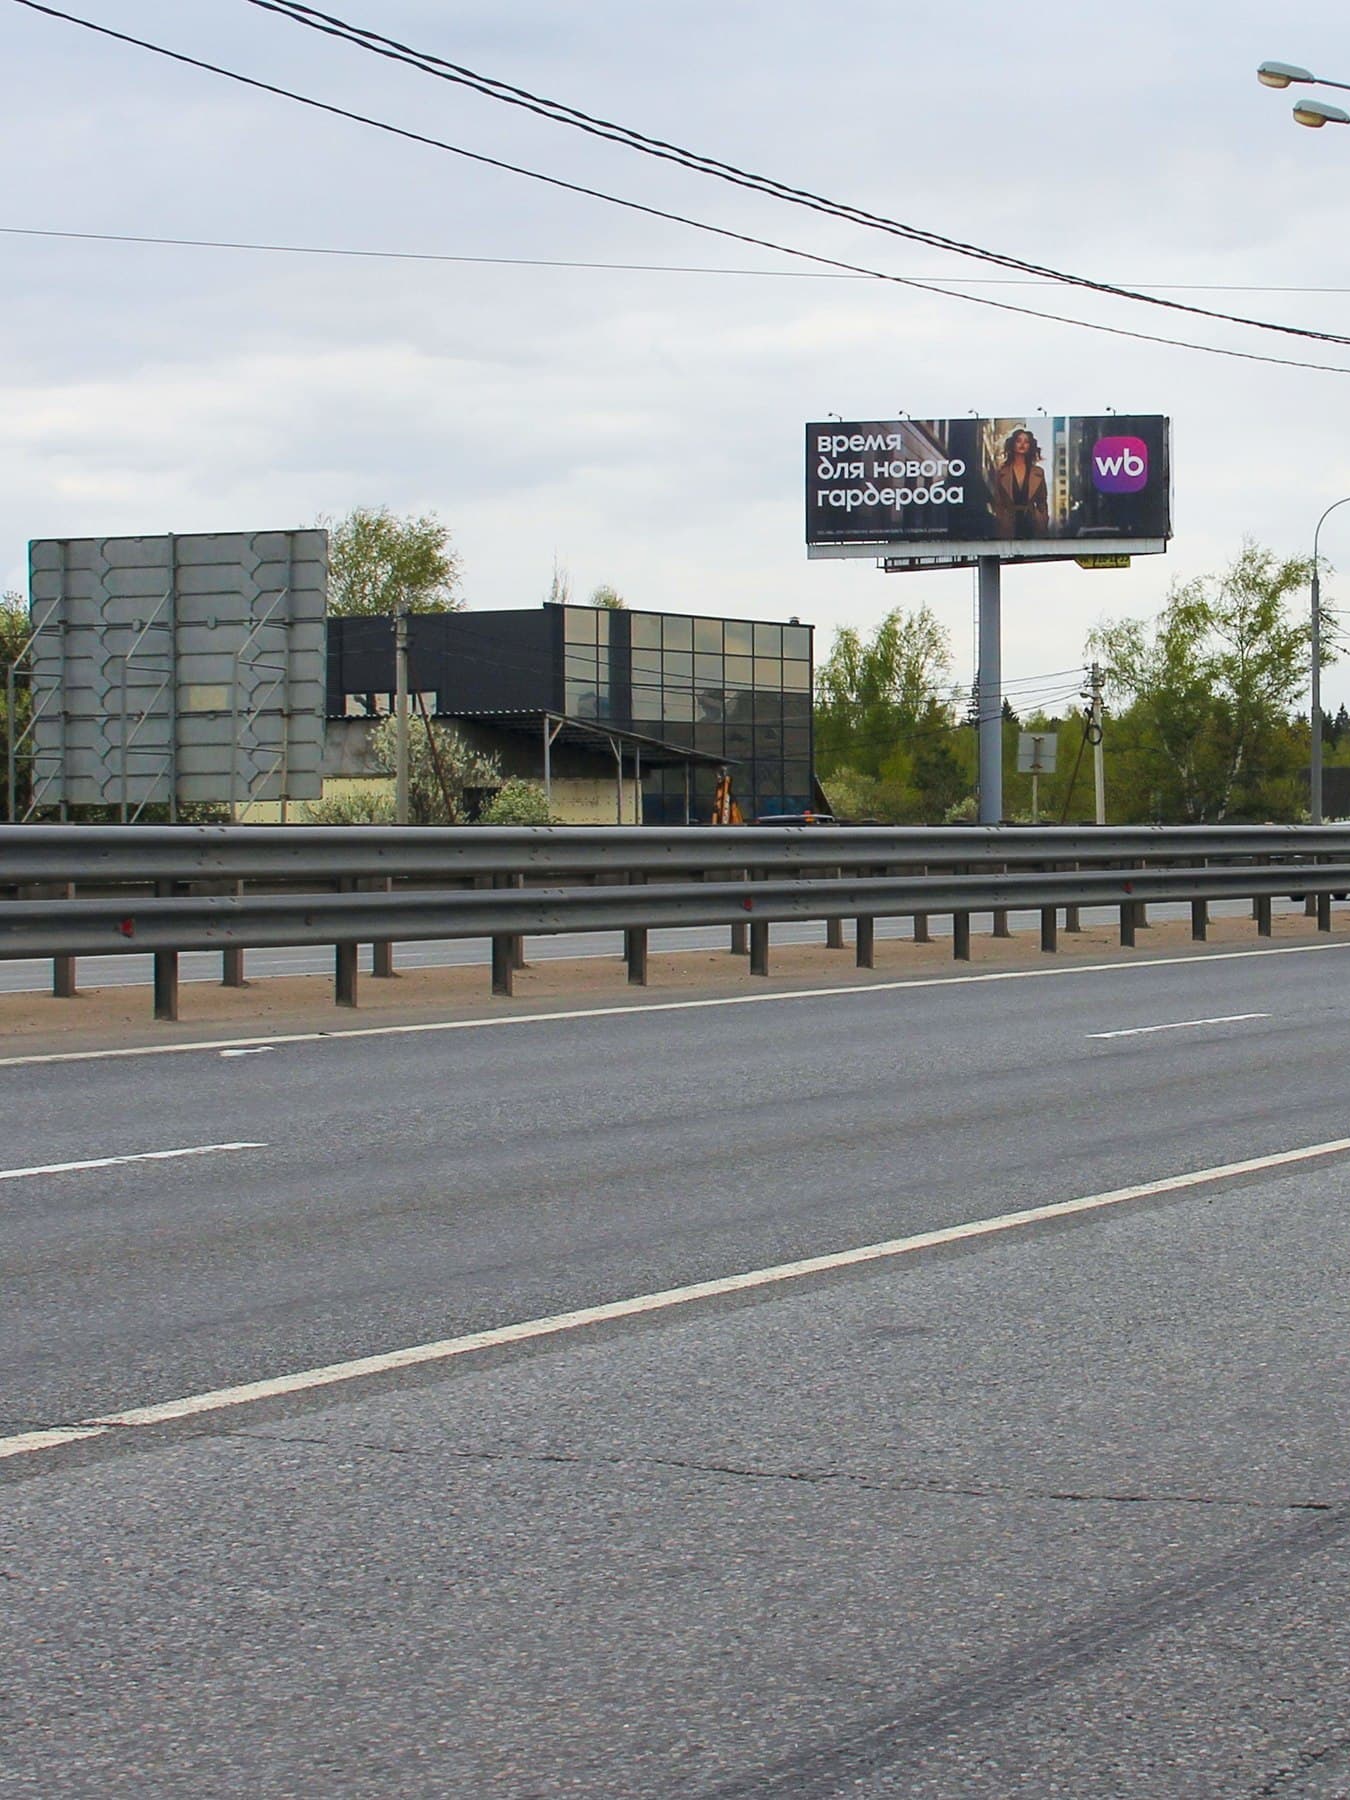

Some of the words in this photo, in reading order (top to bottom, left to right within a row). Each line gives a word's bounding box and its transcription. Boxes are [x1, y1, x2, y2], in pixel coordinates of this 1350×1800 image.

[817, 434, 902, 458] время
[817, 456, 865, 480] для
[873, 458, 966, 479] нового
[1095, 447, 1145, 477] wb
[817, 481, 964, 512] гардероба
